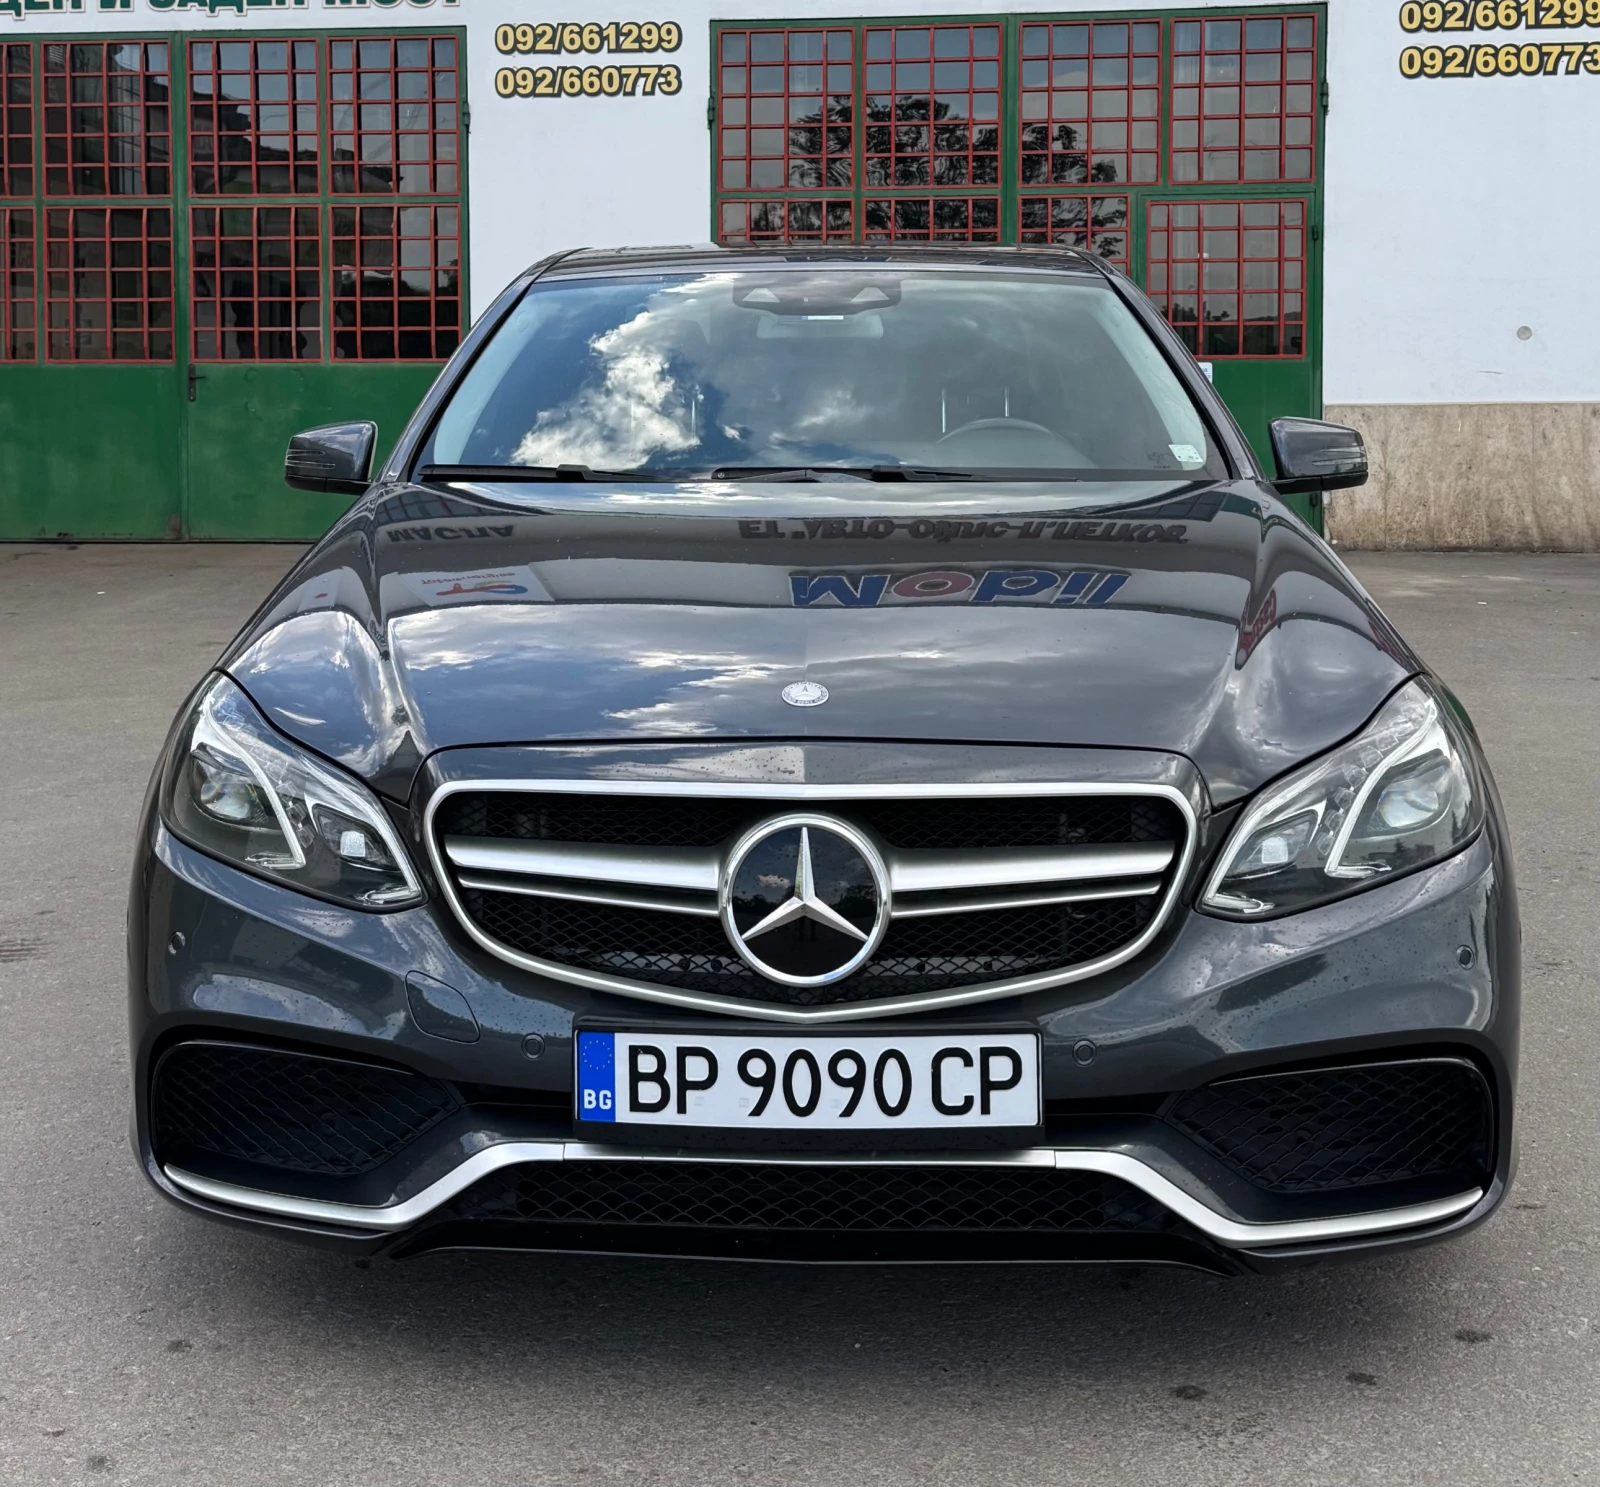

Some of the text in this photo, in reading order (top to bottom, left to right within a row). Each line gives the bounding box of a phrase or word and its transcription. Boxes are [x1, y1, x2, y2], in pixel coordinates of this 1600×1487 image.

[1399, 0, 1600, 33] 092/661299
[495, 21, 683, 55] 092/661299
[1399, 41, 1600, 79] 092/660773
[495, 64, 682, 99] 092/660773
[628, 1044, 1023, 1118] BP 9090 CP
[583, 1088, 612, 1110] BG
